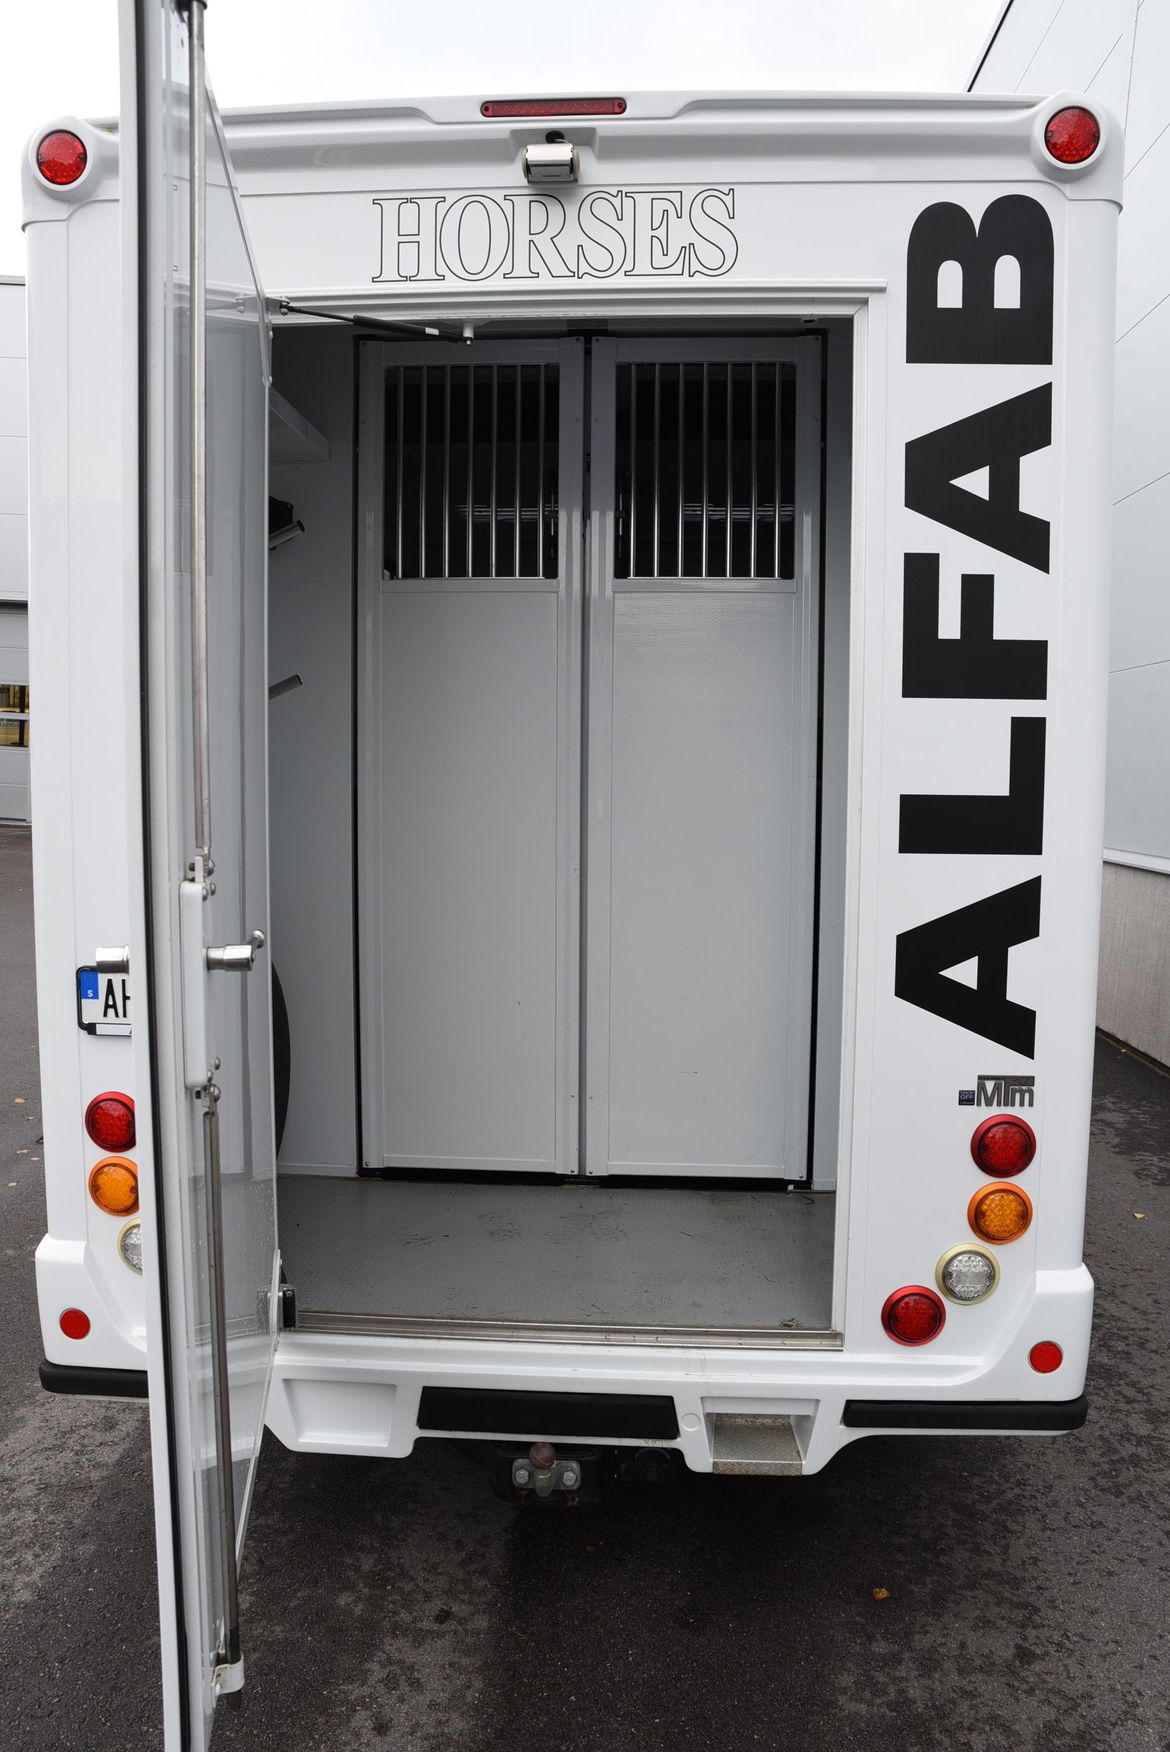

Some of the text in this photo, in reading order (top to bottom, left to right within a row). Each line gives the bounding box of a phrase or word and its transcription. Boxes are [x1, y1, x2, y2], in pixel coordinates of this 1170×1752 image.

[371, 188, 739, 283] HORSES
[894, 194, 1055, 1061] ALFAB
[87, 989, 94, 998] S
